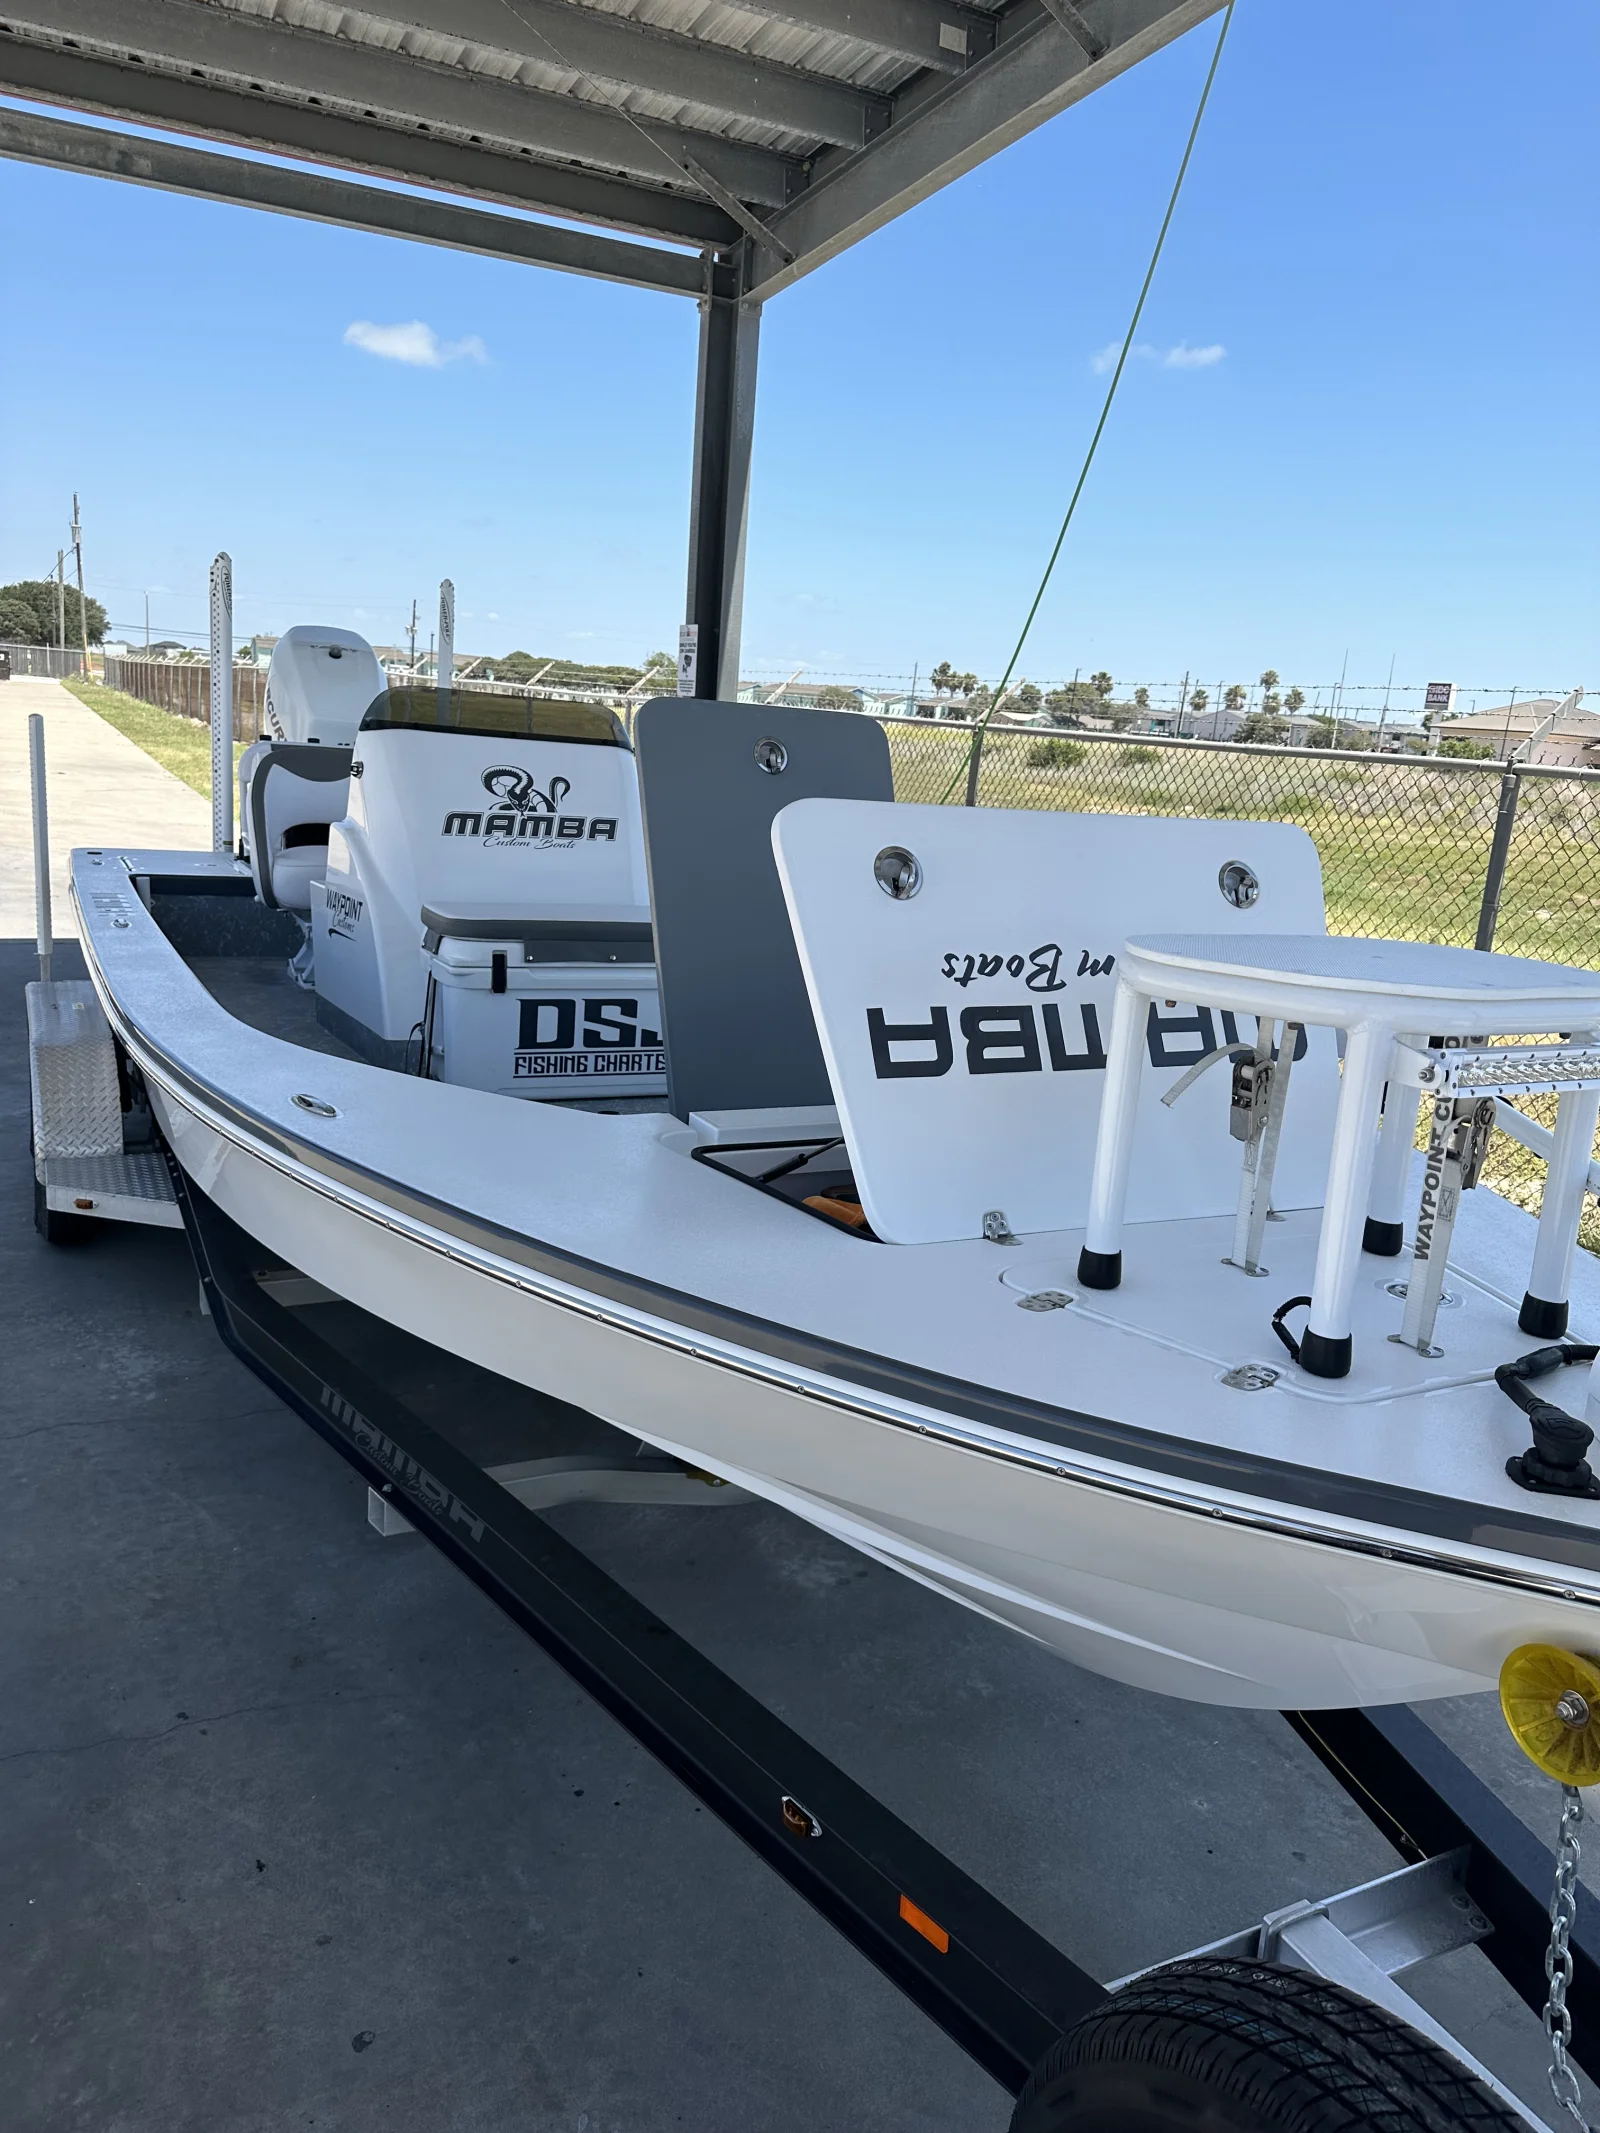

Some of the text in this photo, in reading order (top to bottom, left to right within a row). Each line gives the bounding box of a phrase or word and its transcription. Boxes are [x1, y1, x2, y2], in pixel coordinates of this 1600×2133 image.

[1427, 694, 1448, 702] BANK
[442, 811, 618, 841] MAMBA
[482, 836, 576, 850] Custom Boats
[326, 888, 363, 922] WAYPOINT
[941, 943, 1067, 993] Boats
[514, 1052, 666, 1075] FISHING CHARTE
[1413, 1125, 1447, 1261] WAYPOINT
[320, 1384, 486, 1543] MAMBA
[355, 1431, 400, 1476] Custom
